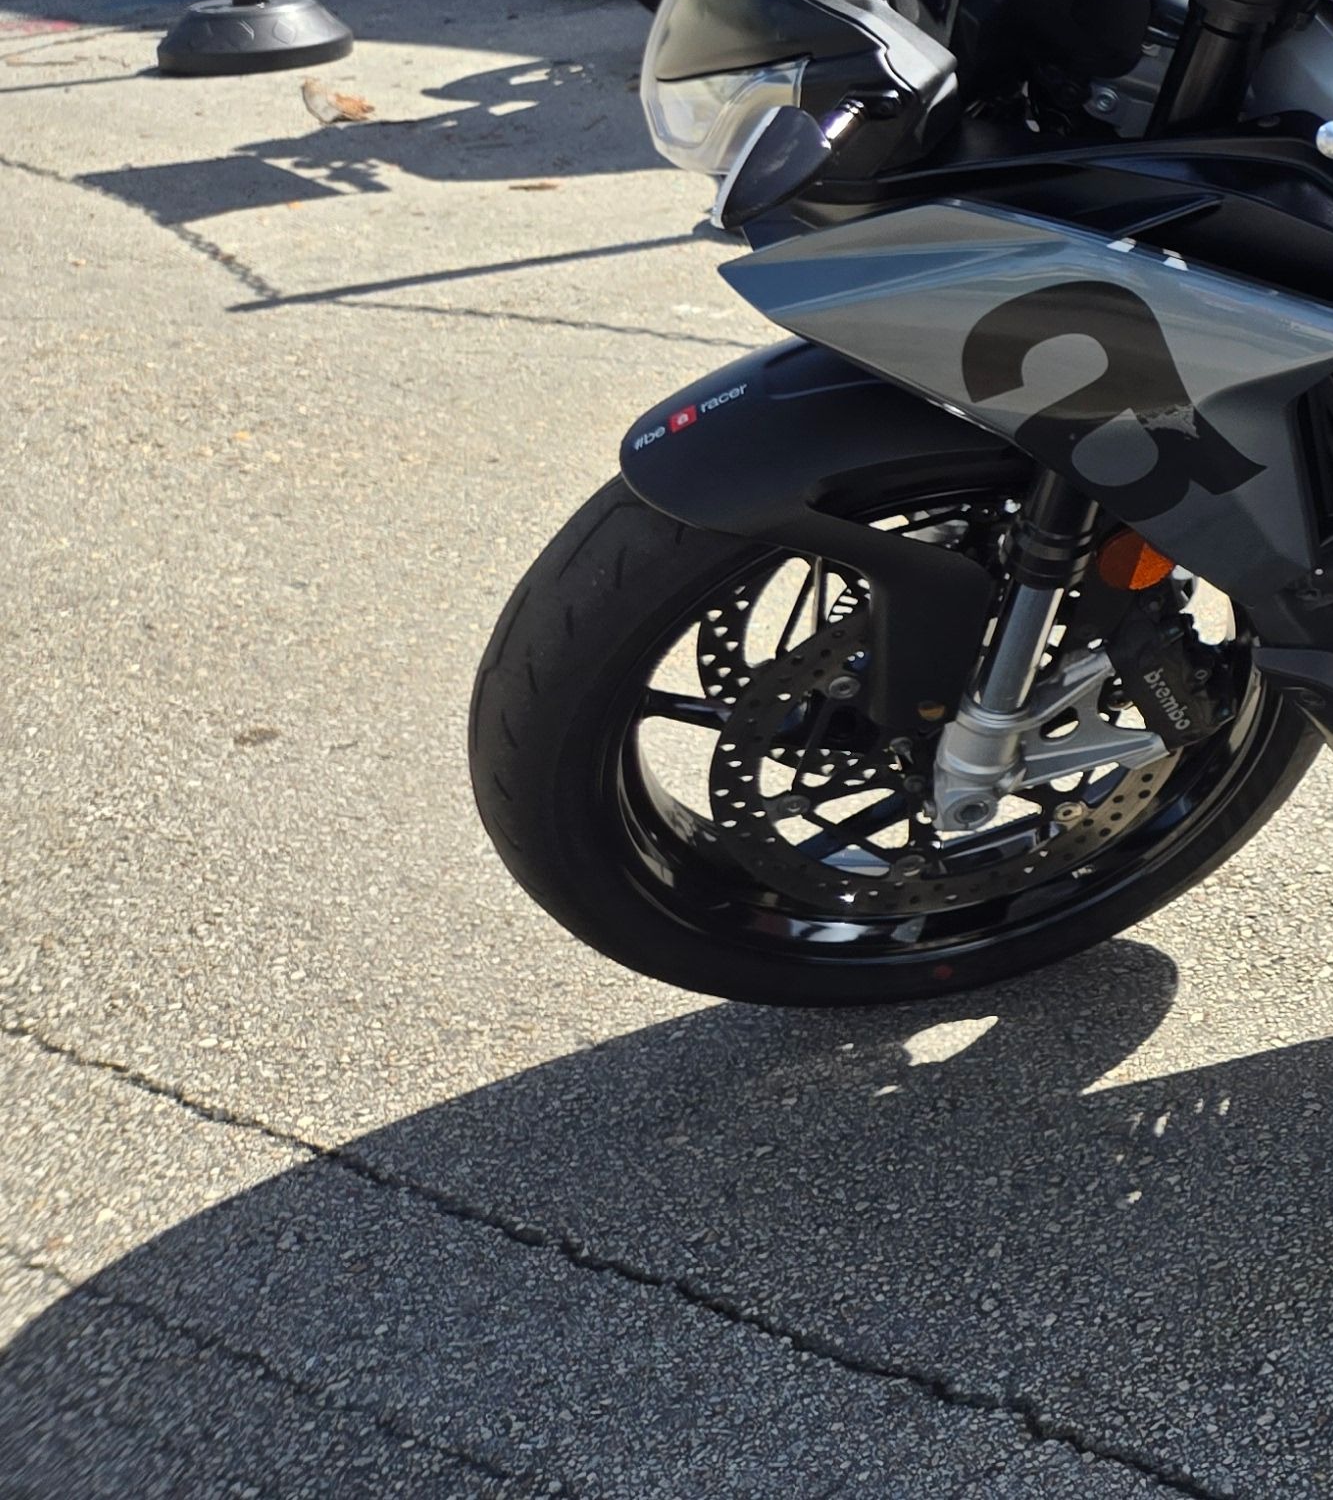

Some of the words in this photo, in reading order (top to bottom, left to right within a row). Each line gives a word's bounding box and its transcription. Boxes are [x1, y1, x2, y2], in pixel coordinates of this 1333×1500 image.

[634, 426, 666, 451] #be
[700, 383, 748, 413] racer
[1143, 668, 1191, 730] brembo
